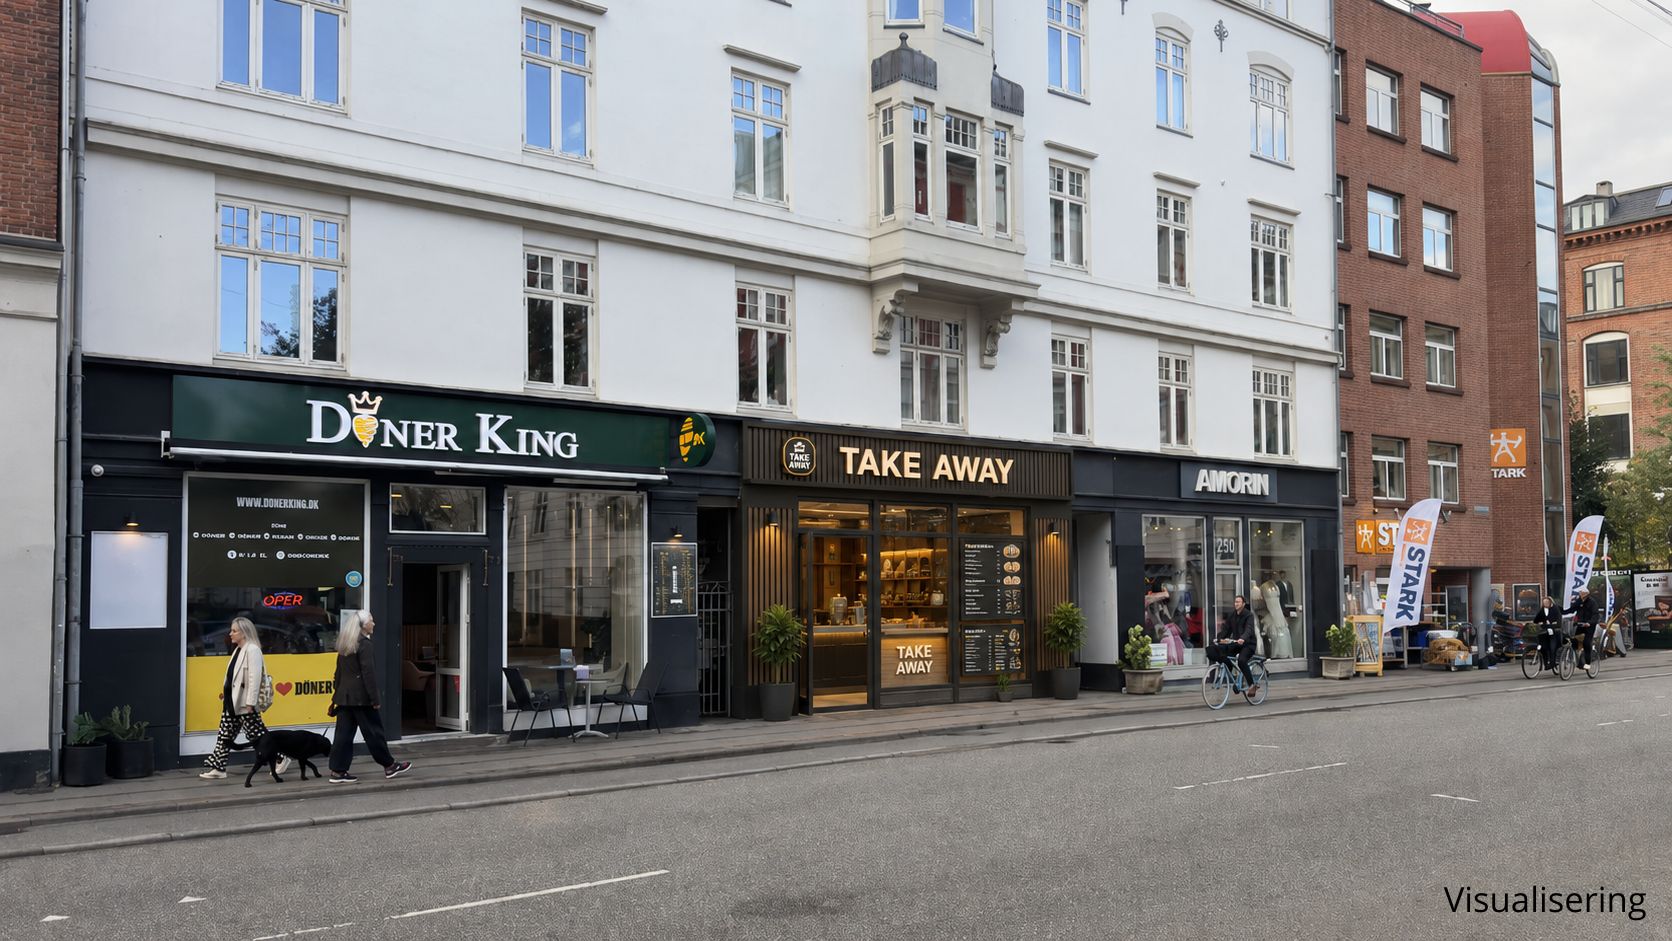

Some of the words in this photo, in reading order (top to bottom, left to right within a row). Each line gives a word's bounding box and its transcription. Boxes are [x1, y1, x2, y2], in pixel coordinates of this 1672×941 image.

[475, 413, 579, 459] KING
[789, 453, 810, 462] TAKE
[839, 446, 921, 479] TAKE
[932, 454, 1014, 485] AWAY
[1490, 467, 1527, 479] TARK
[1195, 468, 1269, 496] AMORIN
[1216, 538, 1235, 553] 250
[1395, 546, 1425, 621] STARK
[896, 644, 933, 659] TAKE
[895, 660, 934, 675] AWAY
[294, 681, 336, 696] DÖNER
